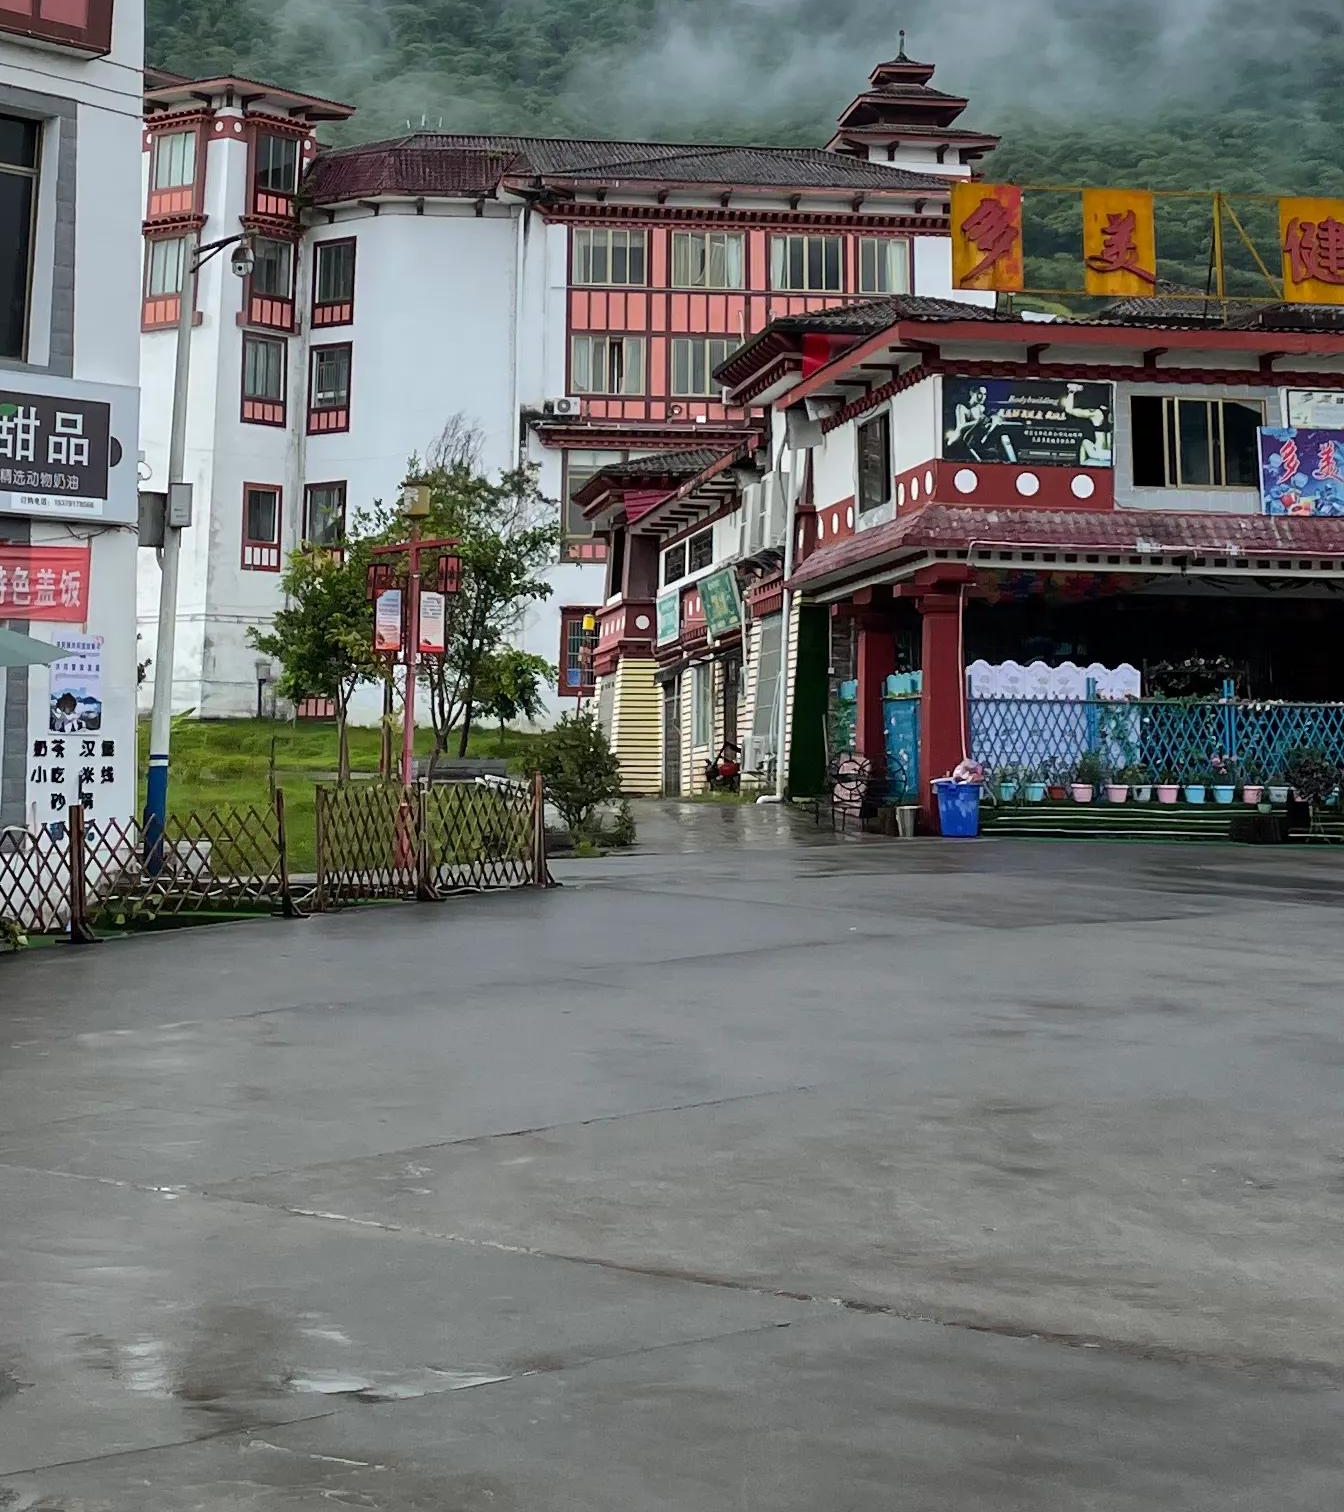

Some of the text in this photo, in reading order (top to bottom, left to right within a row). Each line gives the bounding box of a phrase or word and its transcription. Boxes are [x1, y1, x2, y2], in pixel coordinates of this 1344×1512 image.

[33, 739, 66, 758] 奶茶
[30, 765, 115, 784] 小吃 米线
